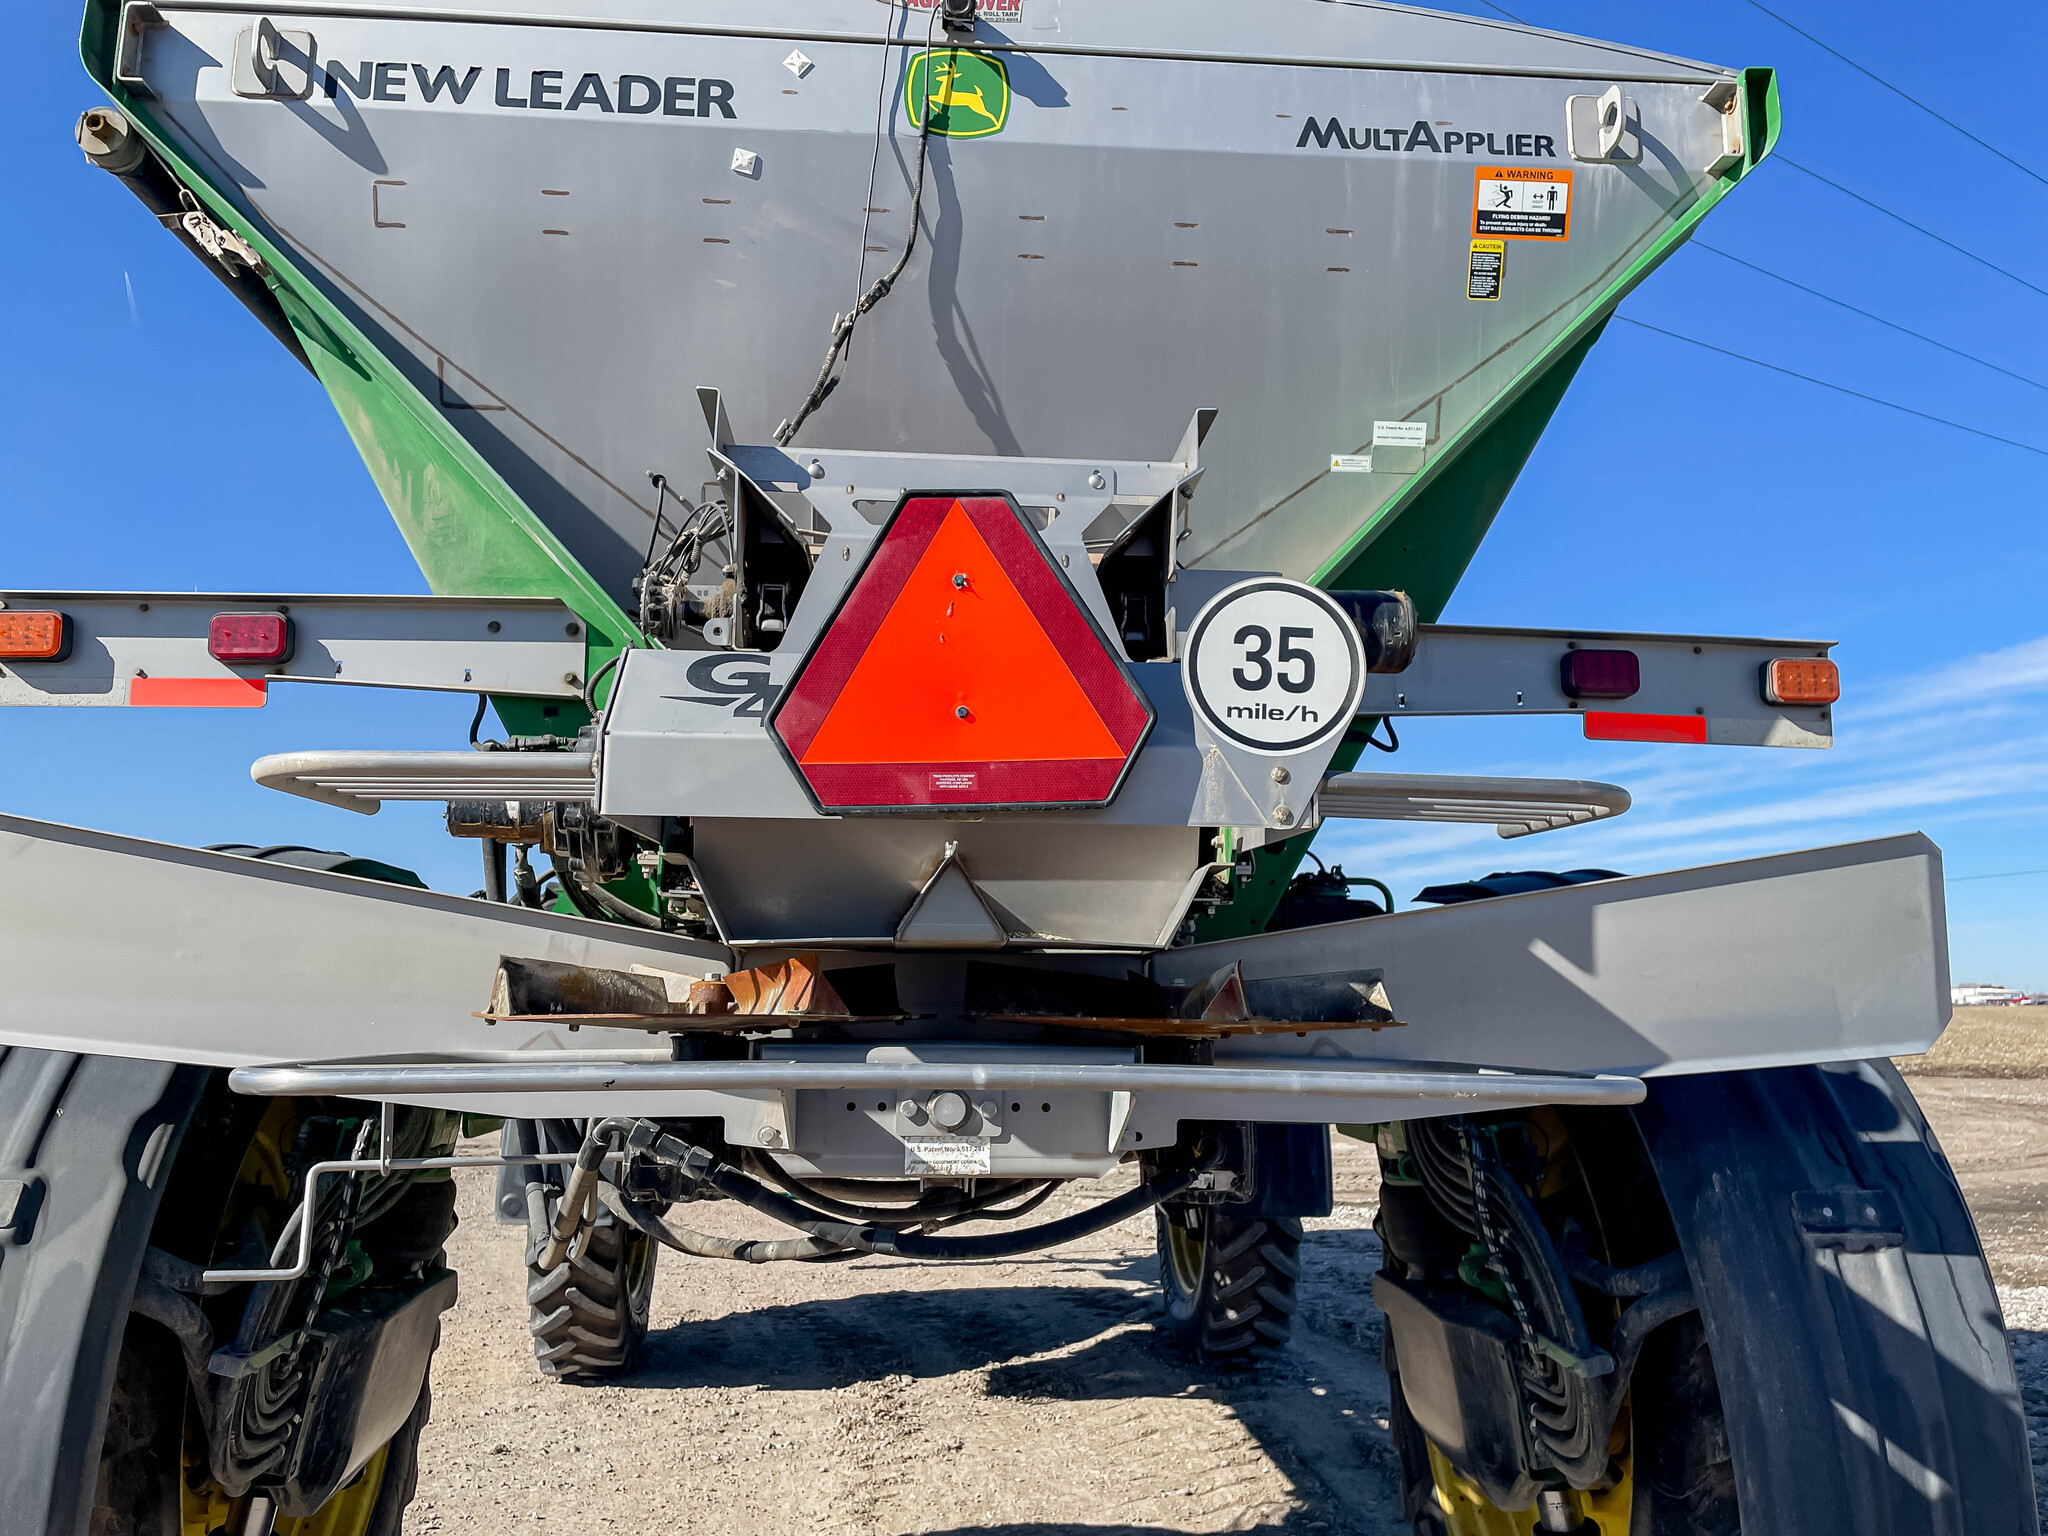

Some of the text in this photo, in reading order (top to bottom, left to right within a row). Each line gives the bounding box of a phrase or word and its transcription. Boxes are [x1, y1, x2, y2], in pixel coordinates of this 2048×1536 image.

[323, 60, 738, 120] NEW LEADER
[1506, 170, 1554, 180] WARNING
[1232, 624, 1316, 693] 35
[1226, 702, 1319, 722] mile/h
